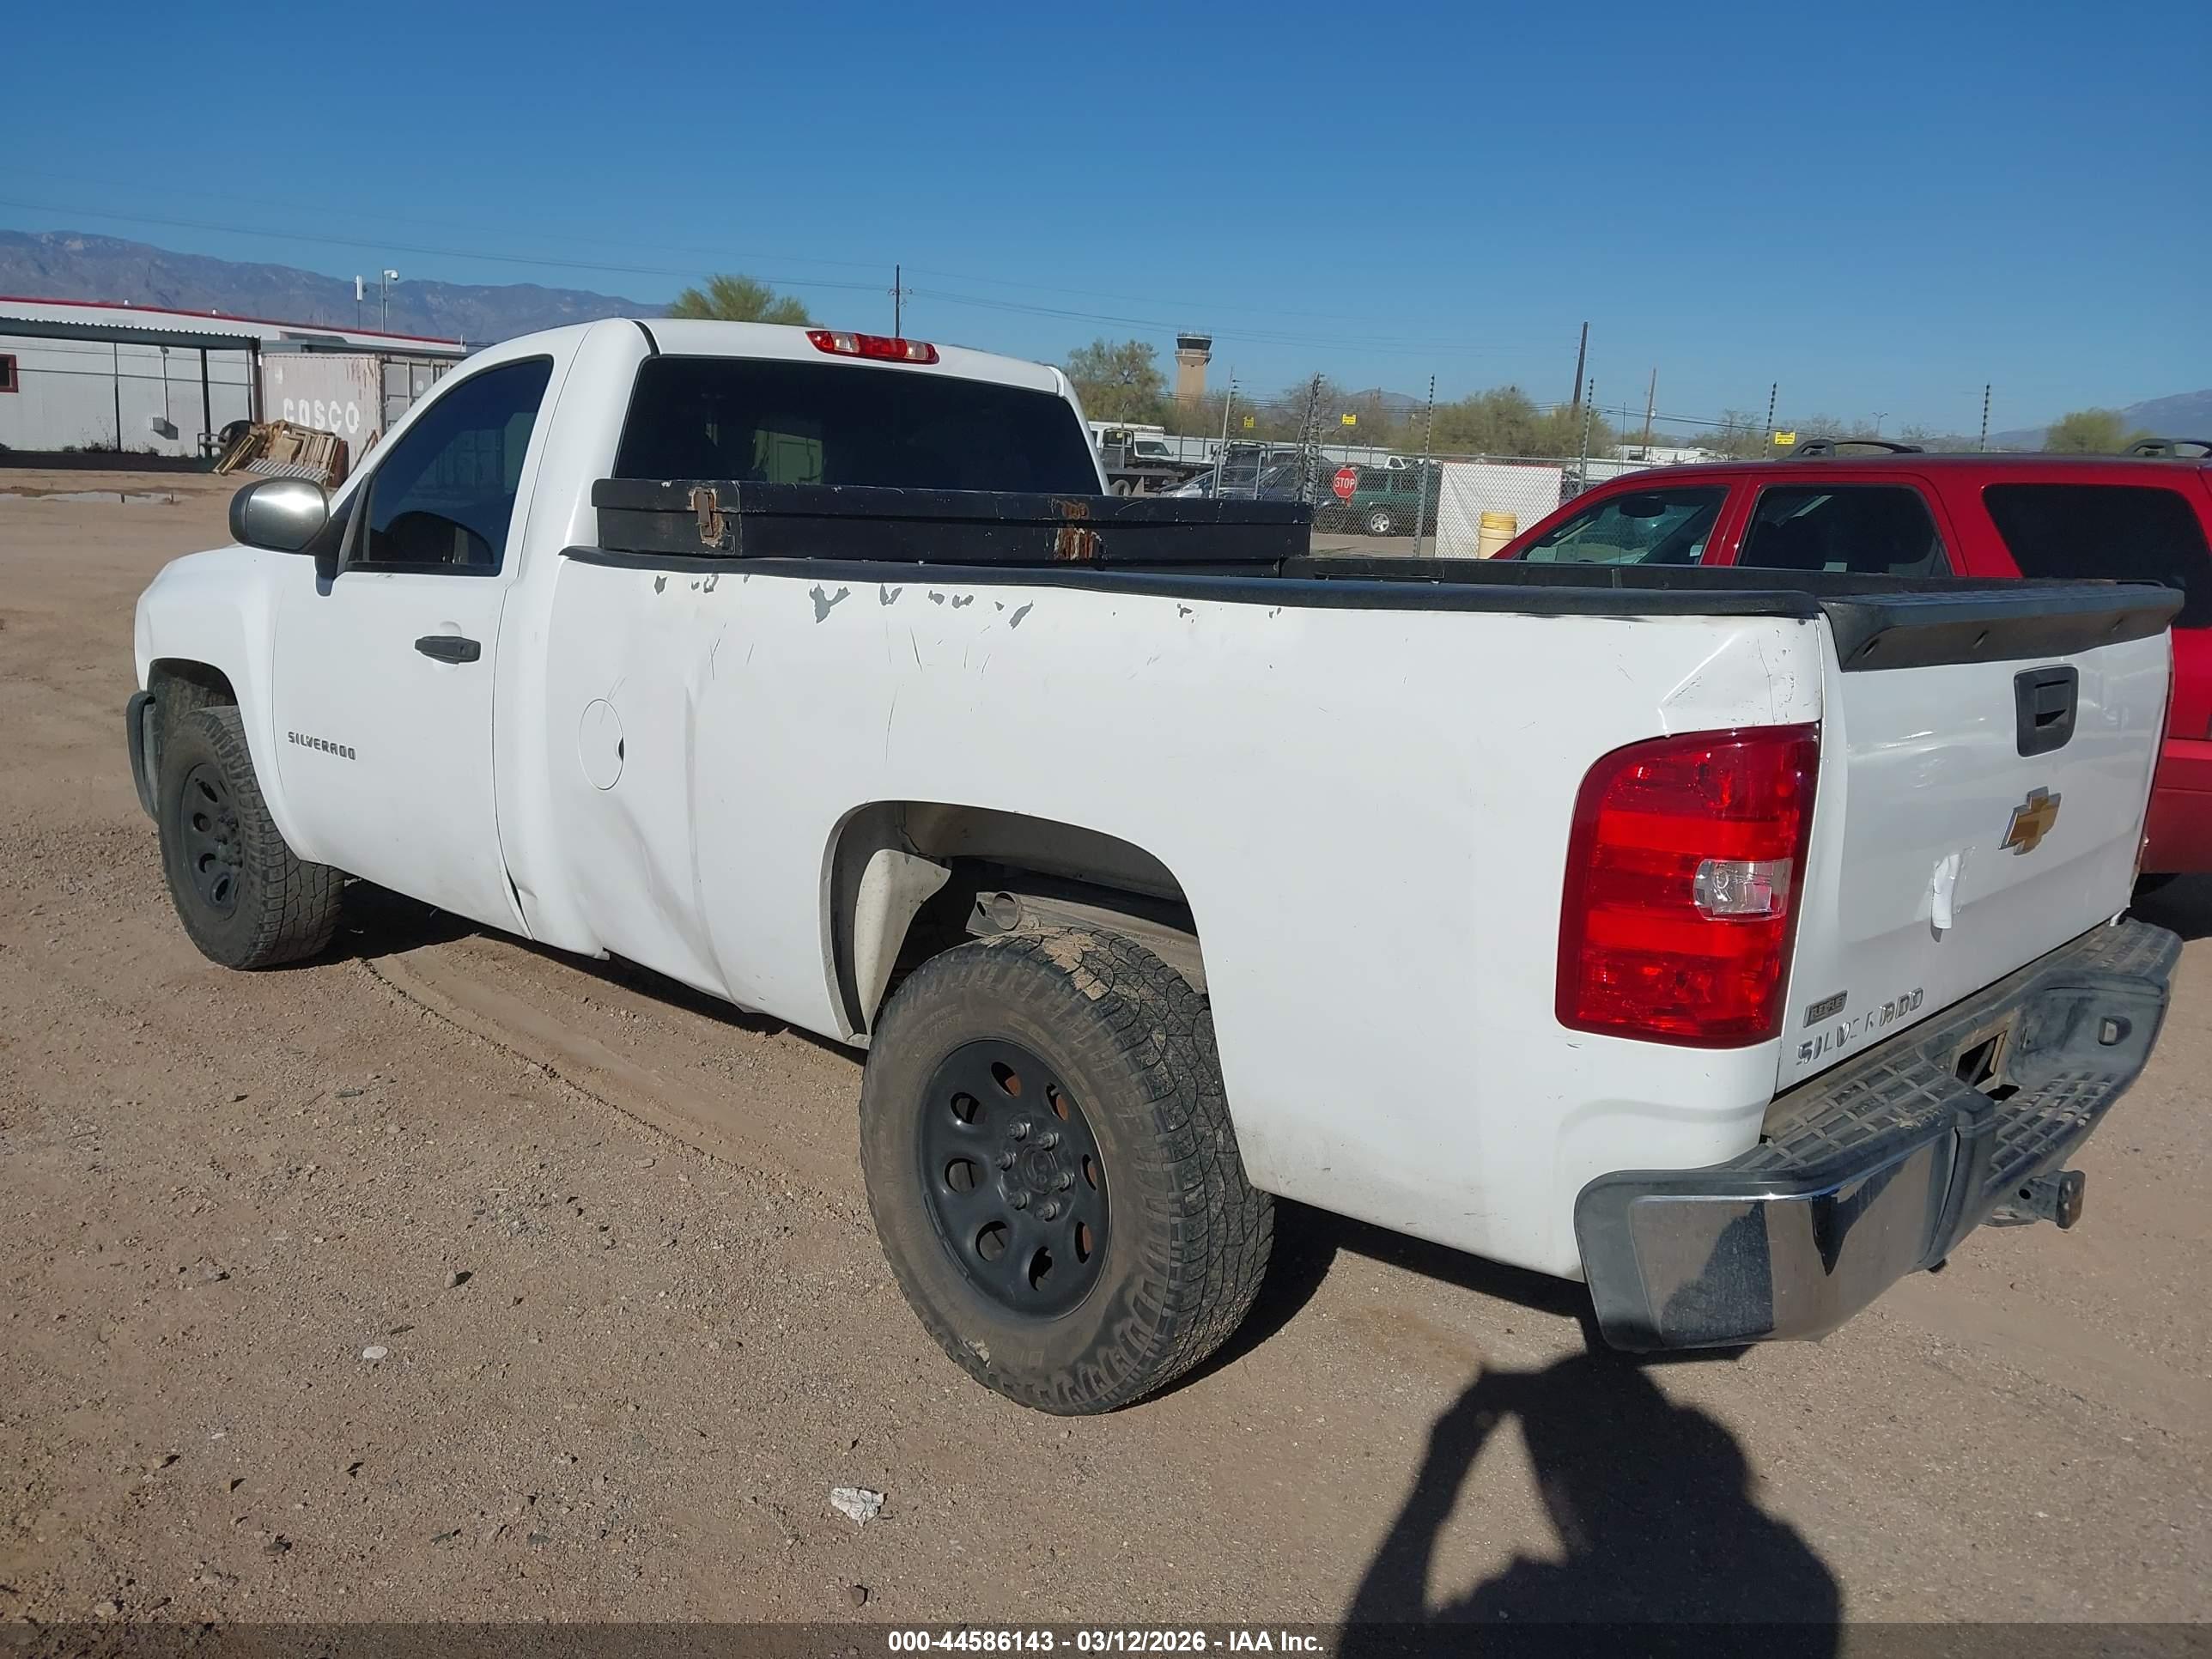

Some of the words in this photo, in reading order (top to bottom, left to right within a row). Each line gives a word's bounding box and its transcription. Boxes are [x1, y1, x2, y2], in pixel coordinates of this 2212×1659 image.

[283, 398, 360, 434] COSCO
[1334, 477, 1355, 489] STOP
[288, 731, 356, 761] SILVERADO
